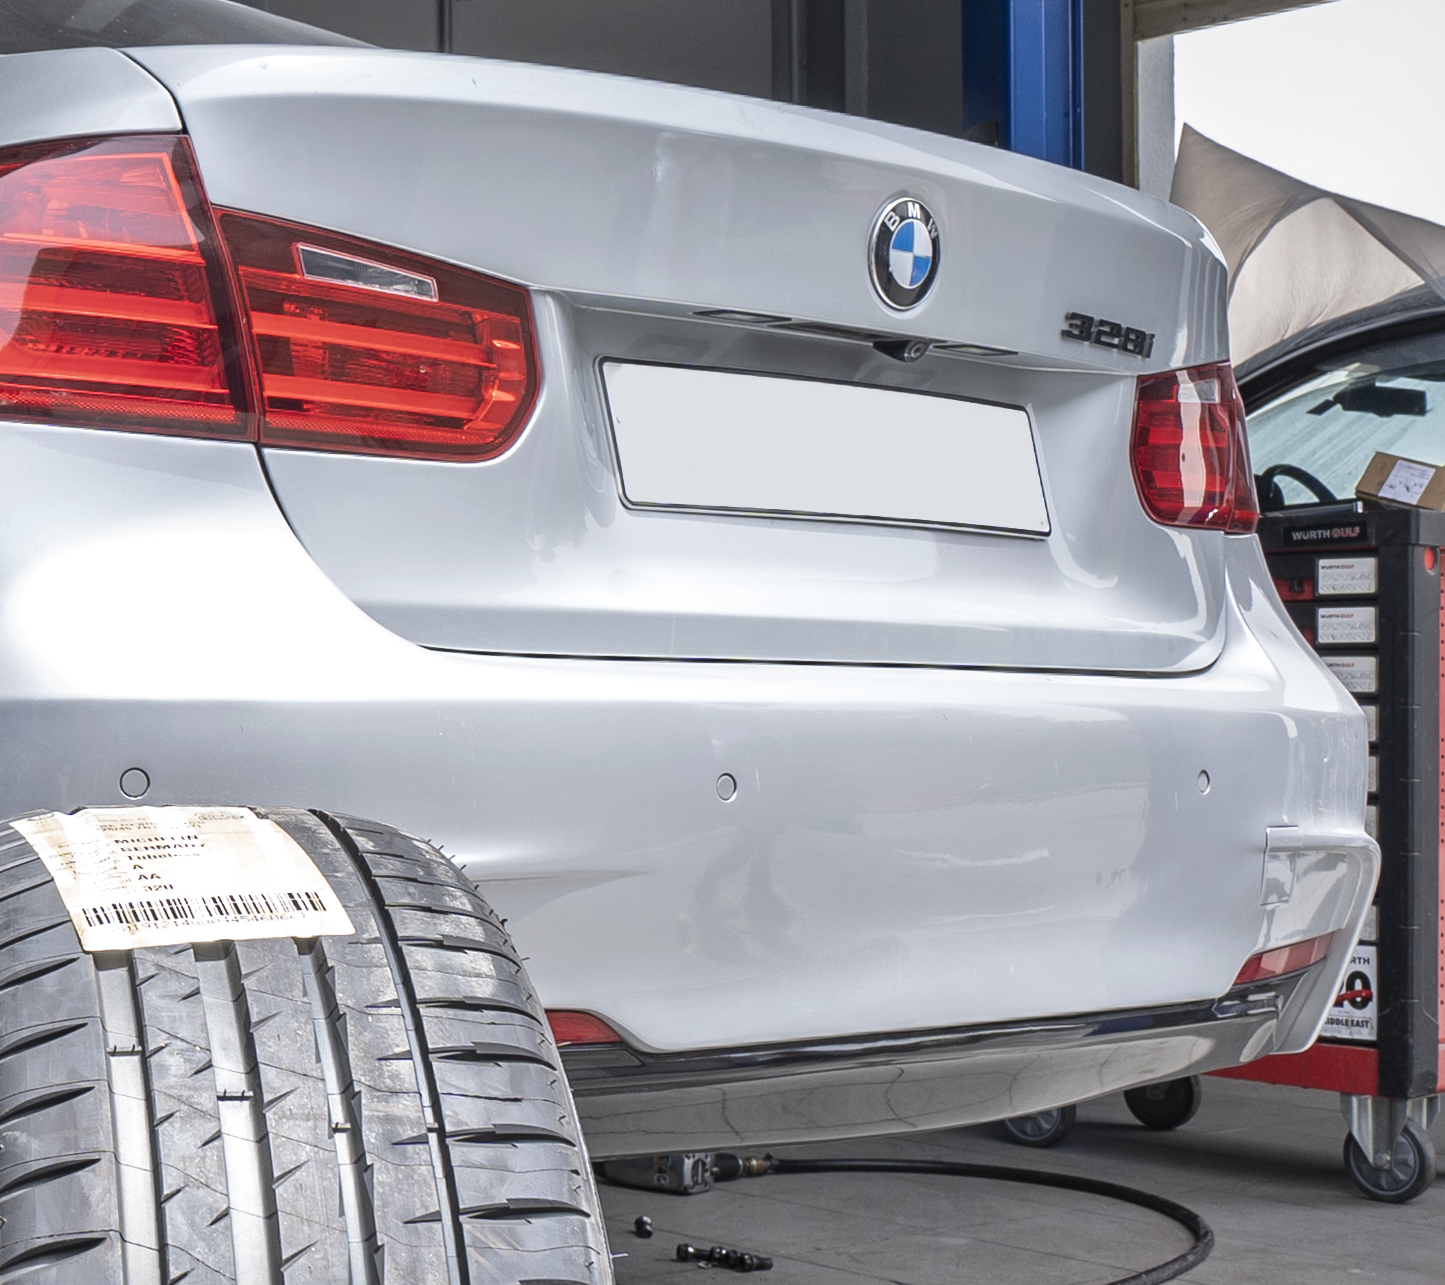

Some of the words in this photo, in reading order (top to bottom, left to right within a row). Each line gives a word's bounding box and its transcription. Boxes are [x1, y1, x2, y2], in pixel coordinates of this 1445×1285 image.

[883, 201, 939, 240] BMW
[1060, 312, 1156, 360] 328i
[1350, 956, 1370, 966] RTH
[1324, 1017, 1349, 1027] IDDLE
[1350, 1018, 1370, 1029] EAST
